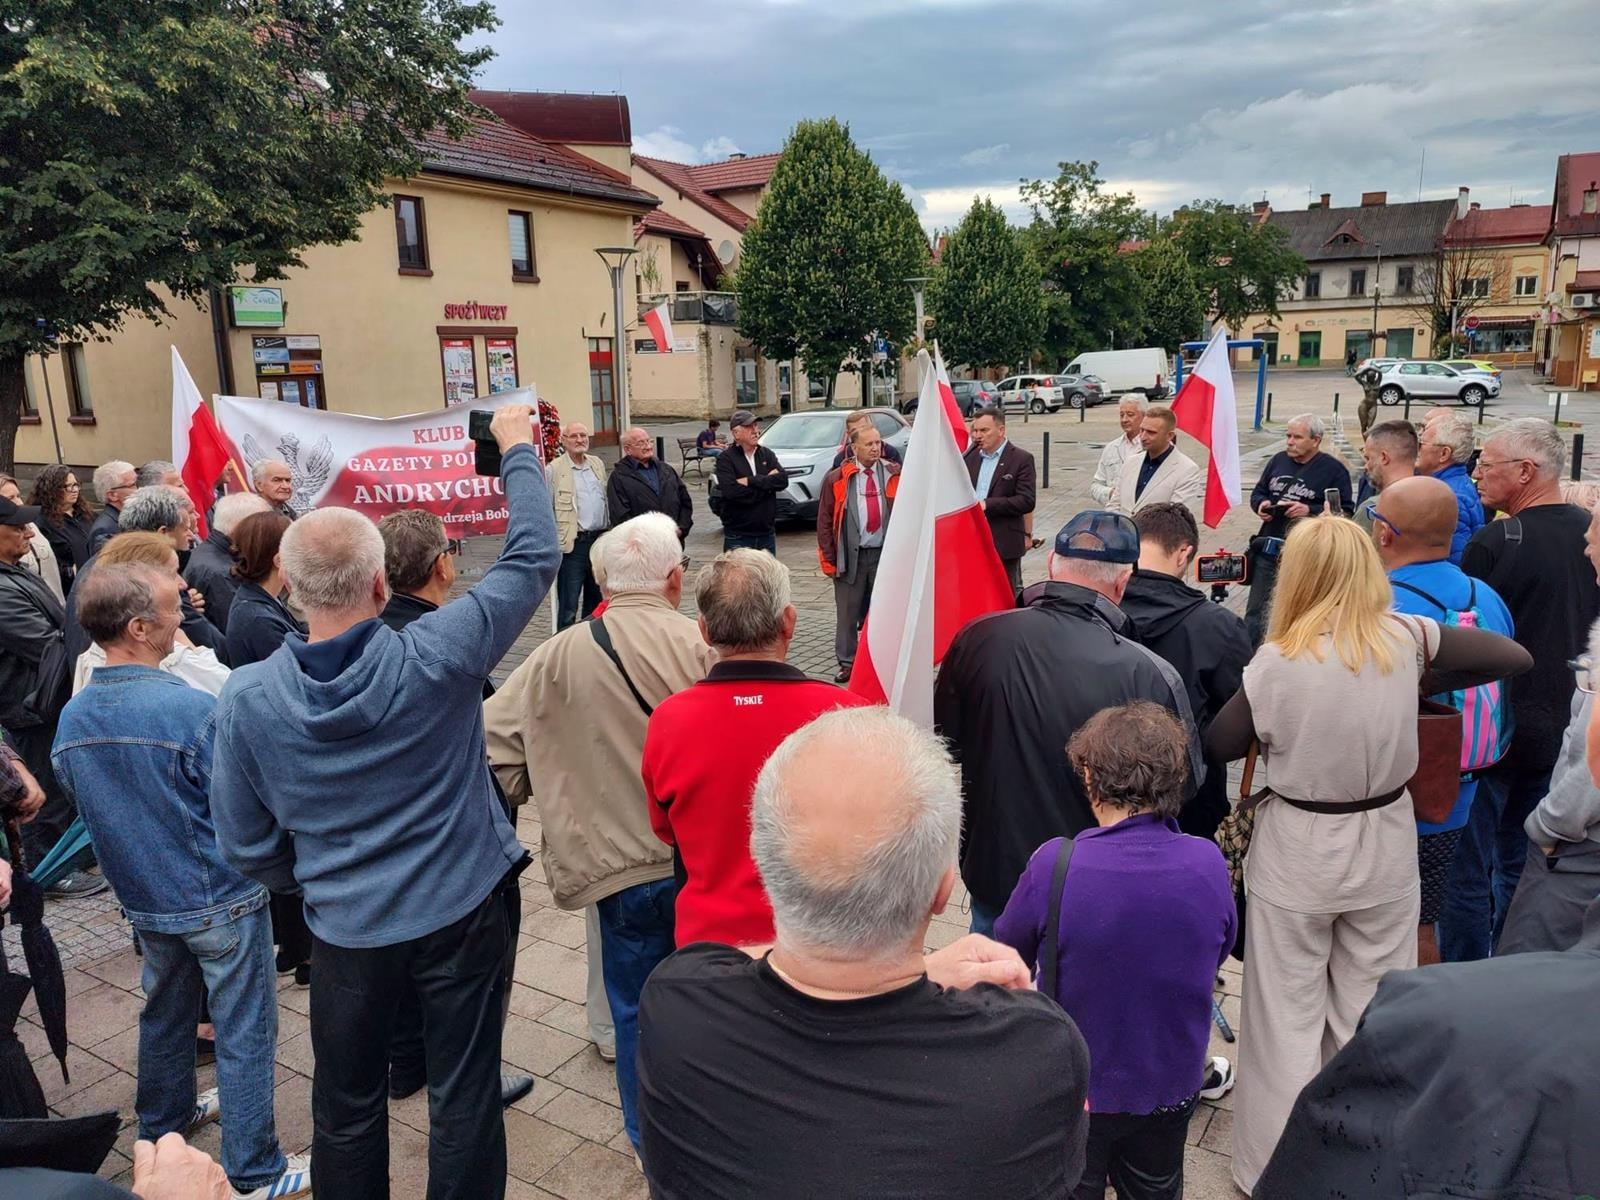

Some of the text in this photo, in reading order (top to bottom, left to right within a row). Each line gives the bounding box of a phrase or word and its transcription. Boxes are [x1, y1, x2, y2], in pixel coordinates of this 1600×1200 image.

[444, 300, 507, 320] SPOŻYWCZY
[412, 425, 465, 444] KLUB
[347, 455, 433, 472] GAZETY
[733, 694, 764, 706] TYSKIE
